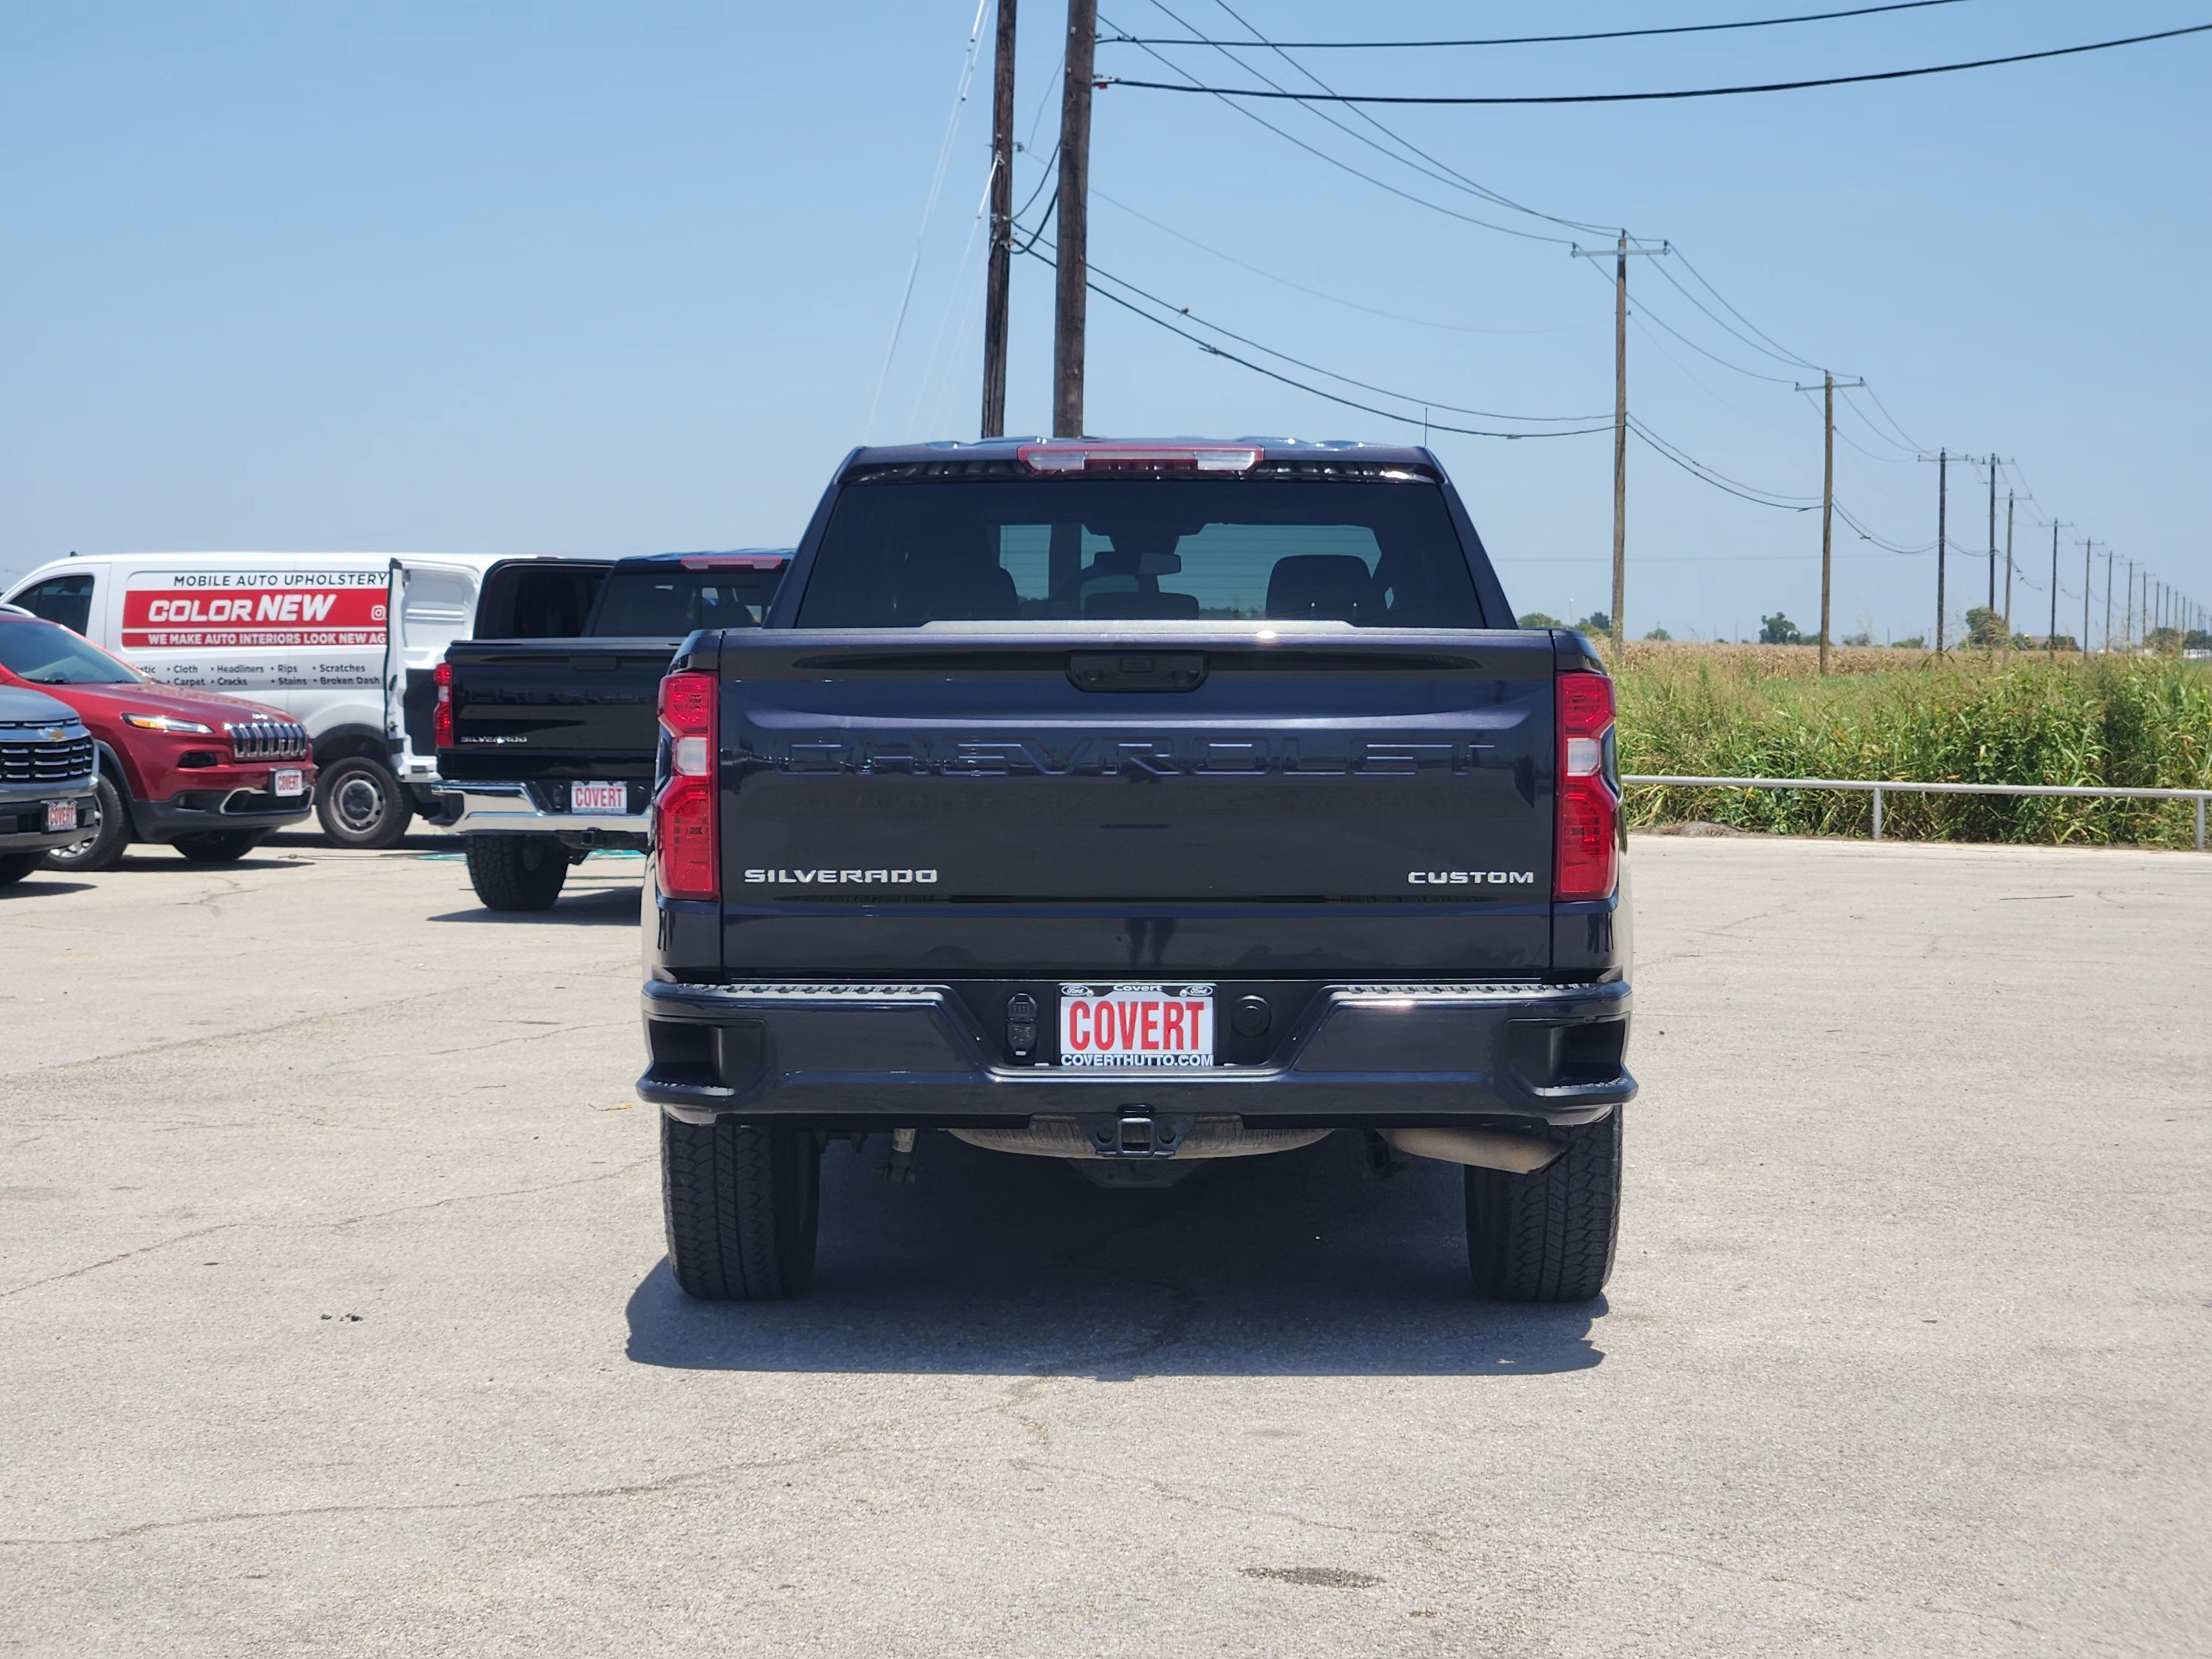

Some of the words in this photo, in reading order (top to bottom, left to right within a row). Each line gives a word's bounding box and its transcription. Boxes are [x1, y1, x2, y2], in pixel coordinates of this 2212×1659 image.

[174, 576, 231, 586] MOBILE
[236, 575, 278, 586] AUTO
[285, 574, 387, 585] UPHOLSTERY
[148, 599, 253, 622] COLOR
[255, 593, 337, 622] NEW
[148, 633, 168, 645] WE
[169, 633, 203, 645] MAKE
[205, 633, 237, 645] AUTO
[239, 633, 301, 645] INTERIORS
[305, 633, 337, 644] LOOK
[339, 632, 367, 644] NEW
[368, 632, 387, 644] AG
[173, 665, 198, 674] Cloth
[217, 665, 264, 673] Headliners
[278, 664, 298, 674] Rips
[319, 664, 366, 672] Scratches
[174, 677, 205, 687] Carpet
[217, 677, 248, 686] Cracks
[278, 677, 307, 685] Stains
[320, 676, 353, 685] Broken
[356, 676, 380, 685] Dash
[774, 736, 1499, 775] CHEVROLET
[575, 787, 622, 807] COVERT
[50, 806, 74, 825] COVERT
[744, 869, 938, 883] SILVERADO
[1407, 871, 1535, 884] CUSTOM
[1070, 1000, 1204, 1051] COVERT
[1061, 1054, 1214, 1066] COVERTHUTTO.COM
